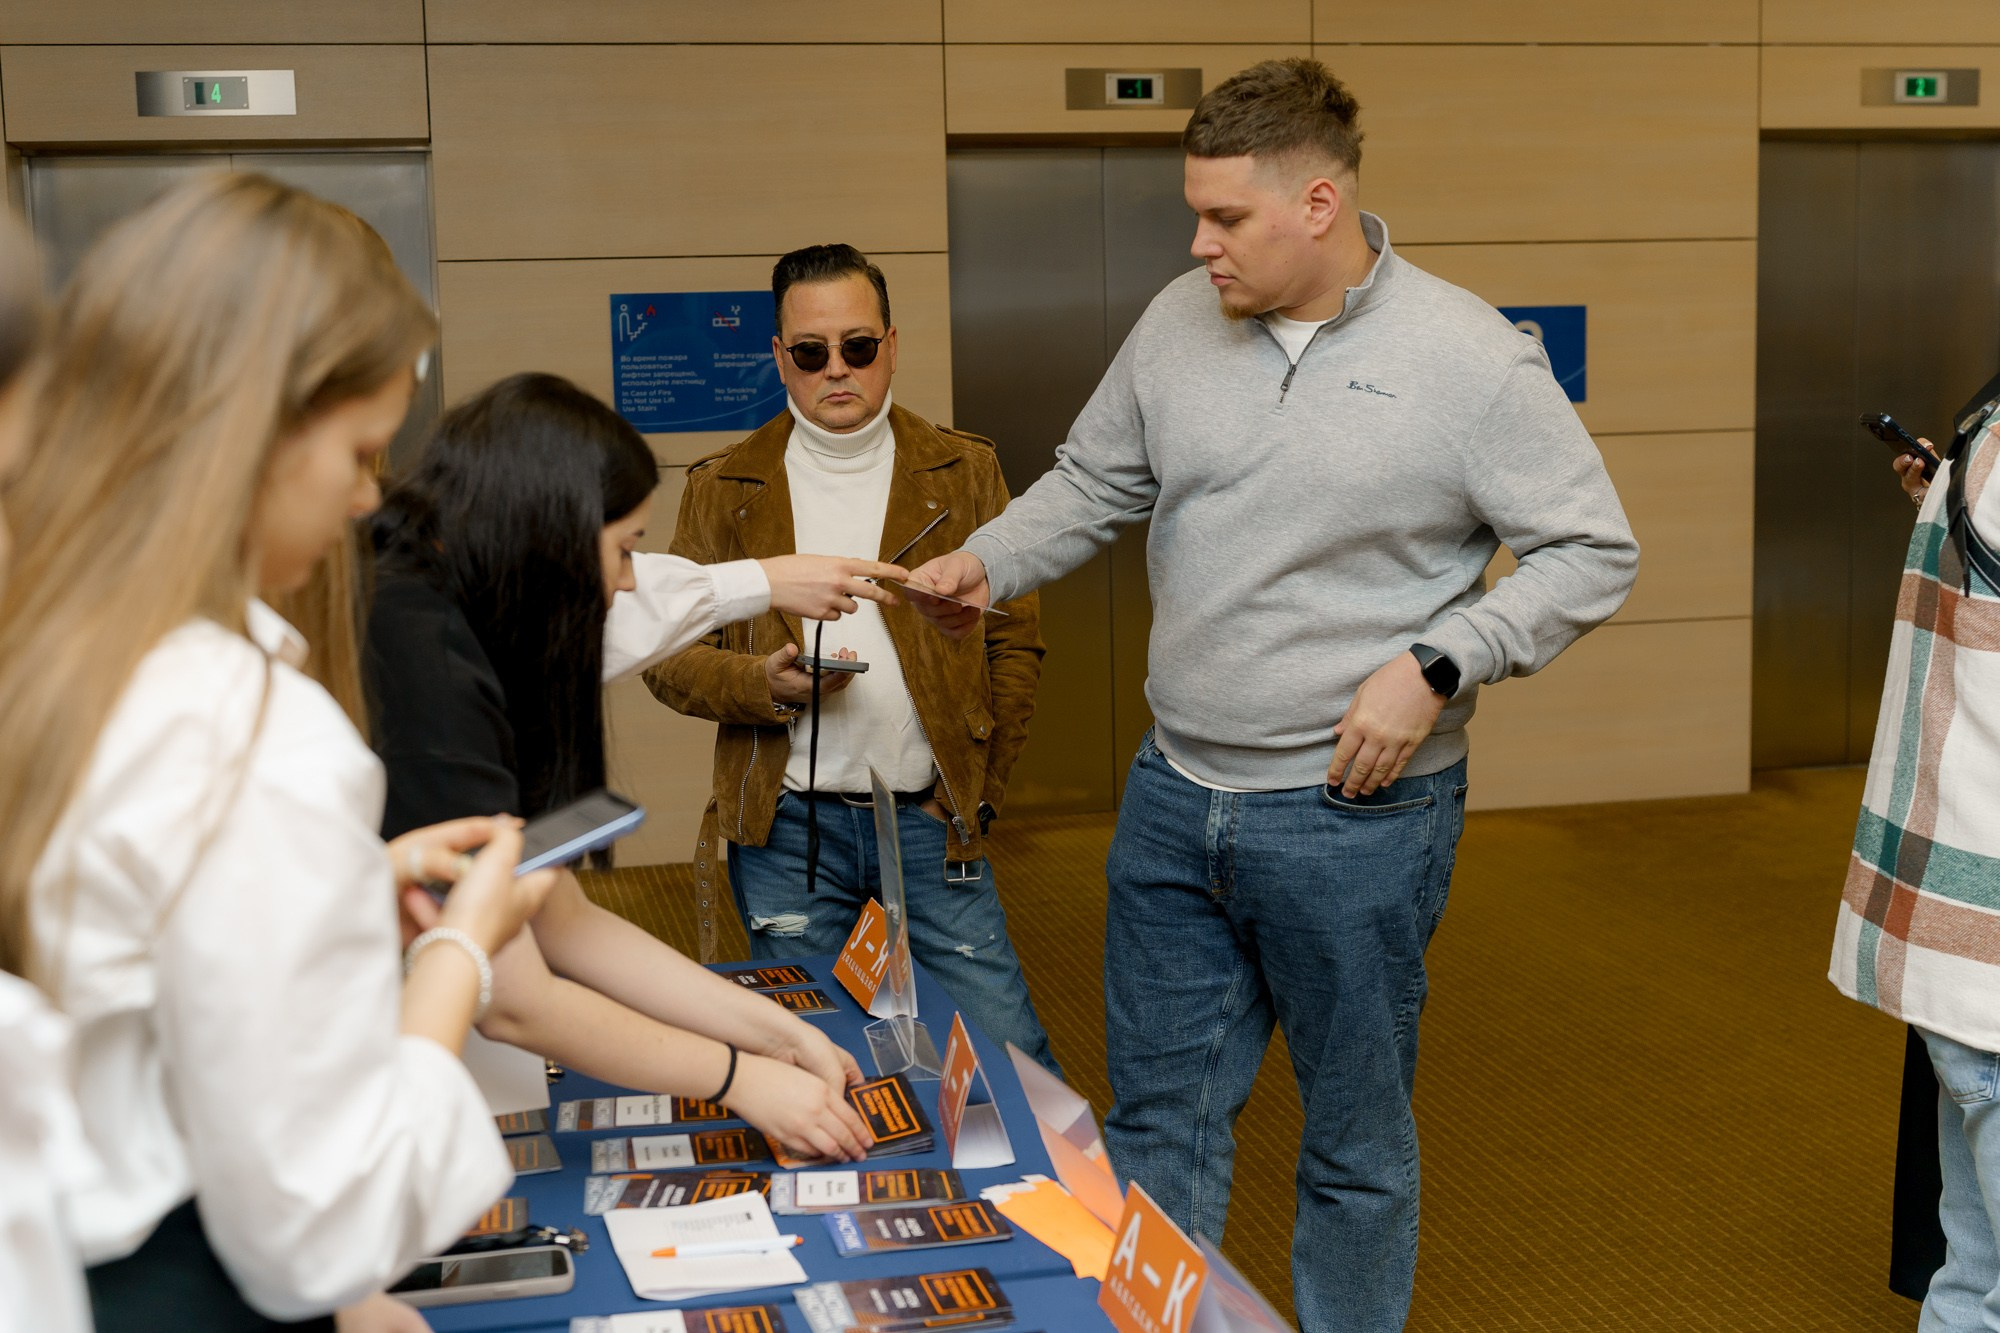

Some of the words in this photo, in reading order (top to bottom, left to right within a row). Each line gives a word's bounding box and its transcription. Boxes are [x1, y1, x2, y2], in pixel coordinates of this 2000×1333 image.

[210, 82, 222, 104] 4
[1127, 80, 1142, 98] -1
[622, 379, 670, 387] используйте
[671, 378, 706, 386] лестницу
[726, 387, 758, 395] Smoking
